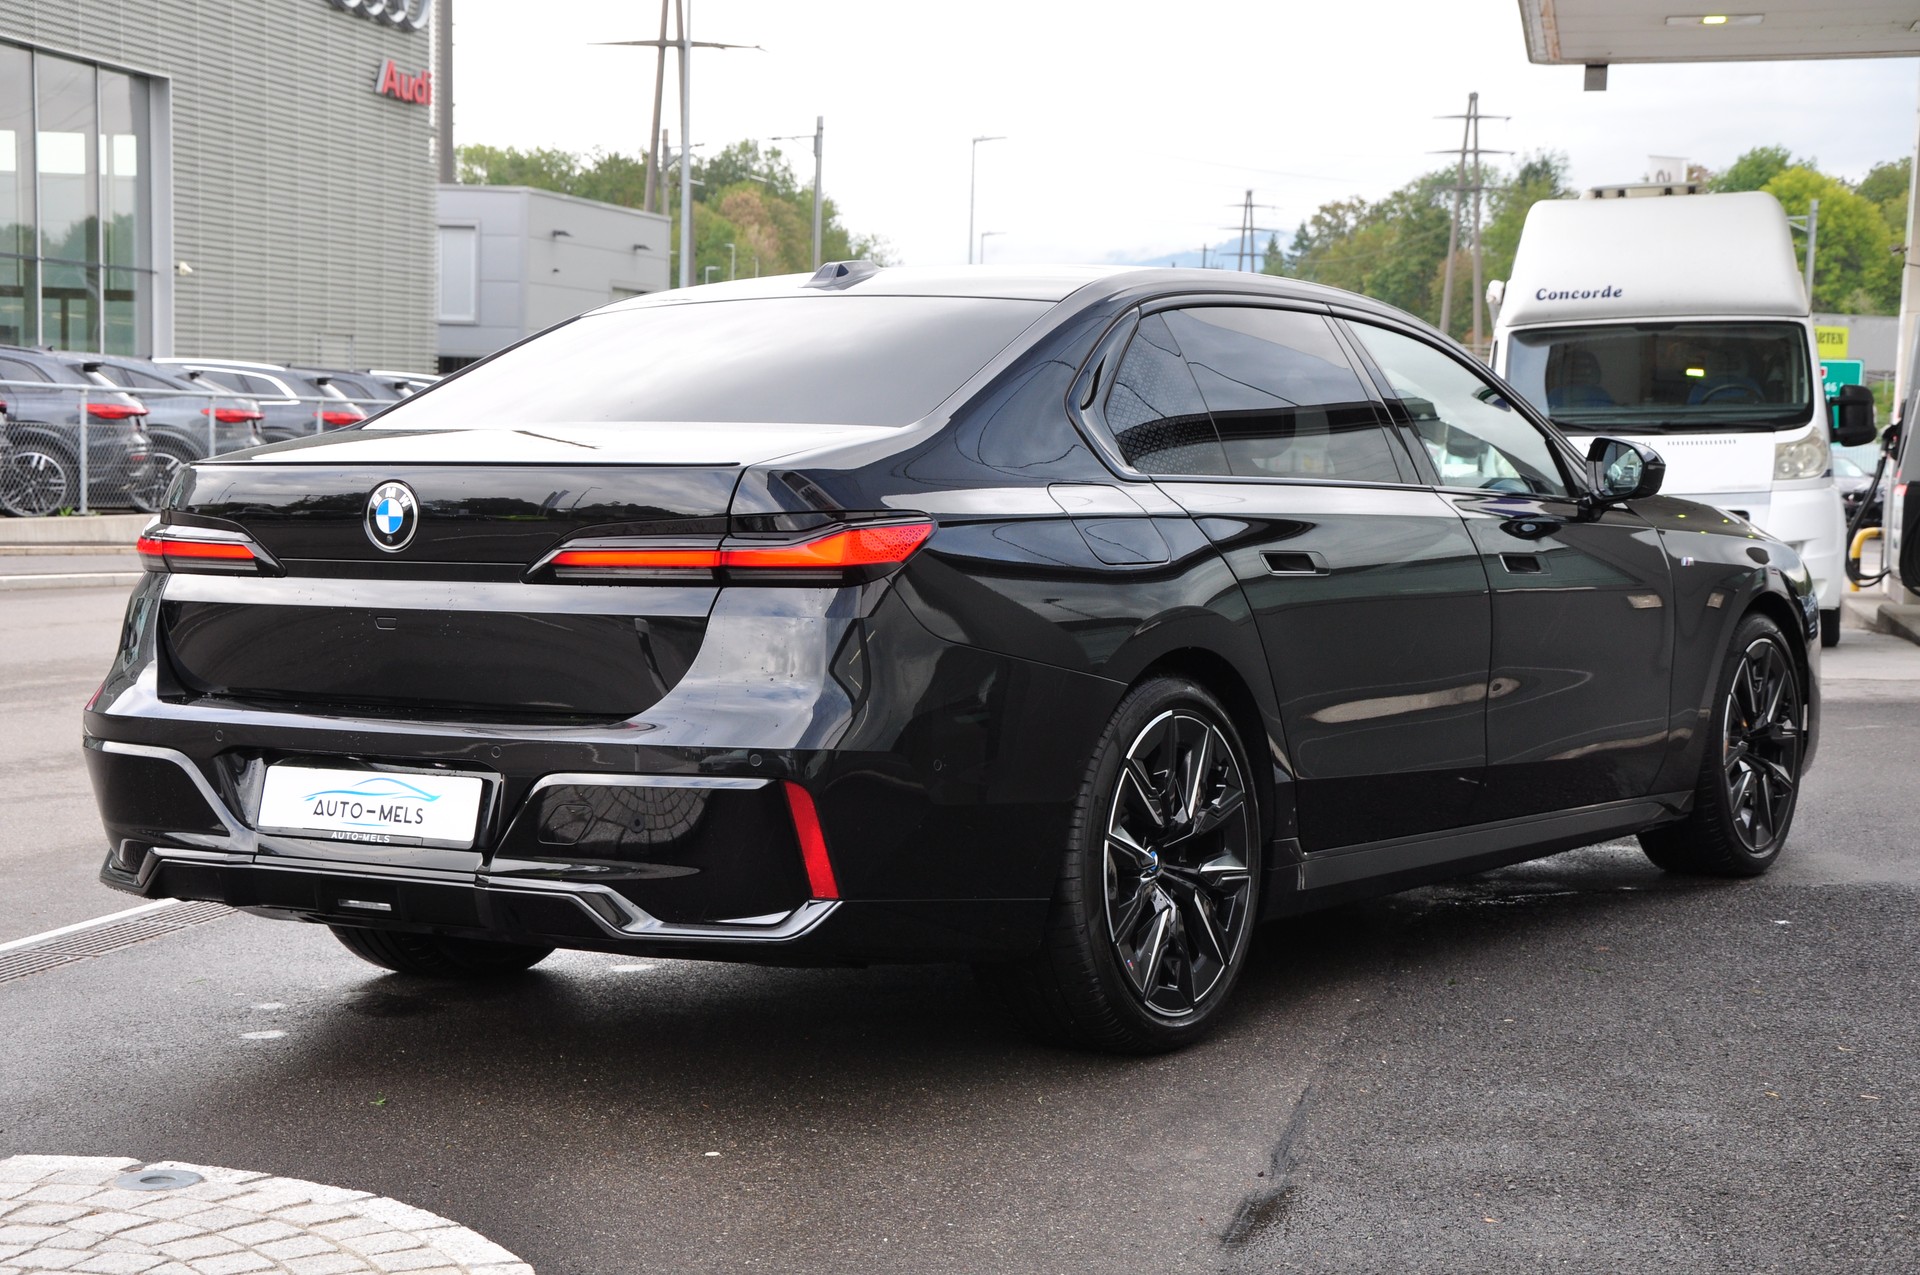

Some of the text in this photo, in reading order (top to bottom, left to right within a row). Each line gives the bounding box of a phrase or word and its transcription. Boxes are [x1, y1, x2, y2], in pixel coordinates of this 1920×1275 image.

[377, 58, 432, 106] Audi
[1535, 285, 1623, 301] Concorde
[372, 487, 411, 508] BMW
[313, 799, 424, 824] AUTO-MELS
[331, 831, 391, 843] AUTO-MELS
